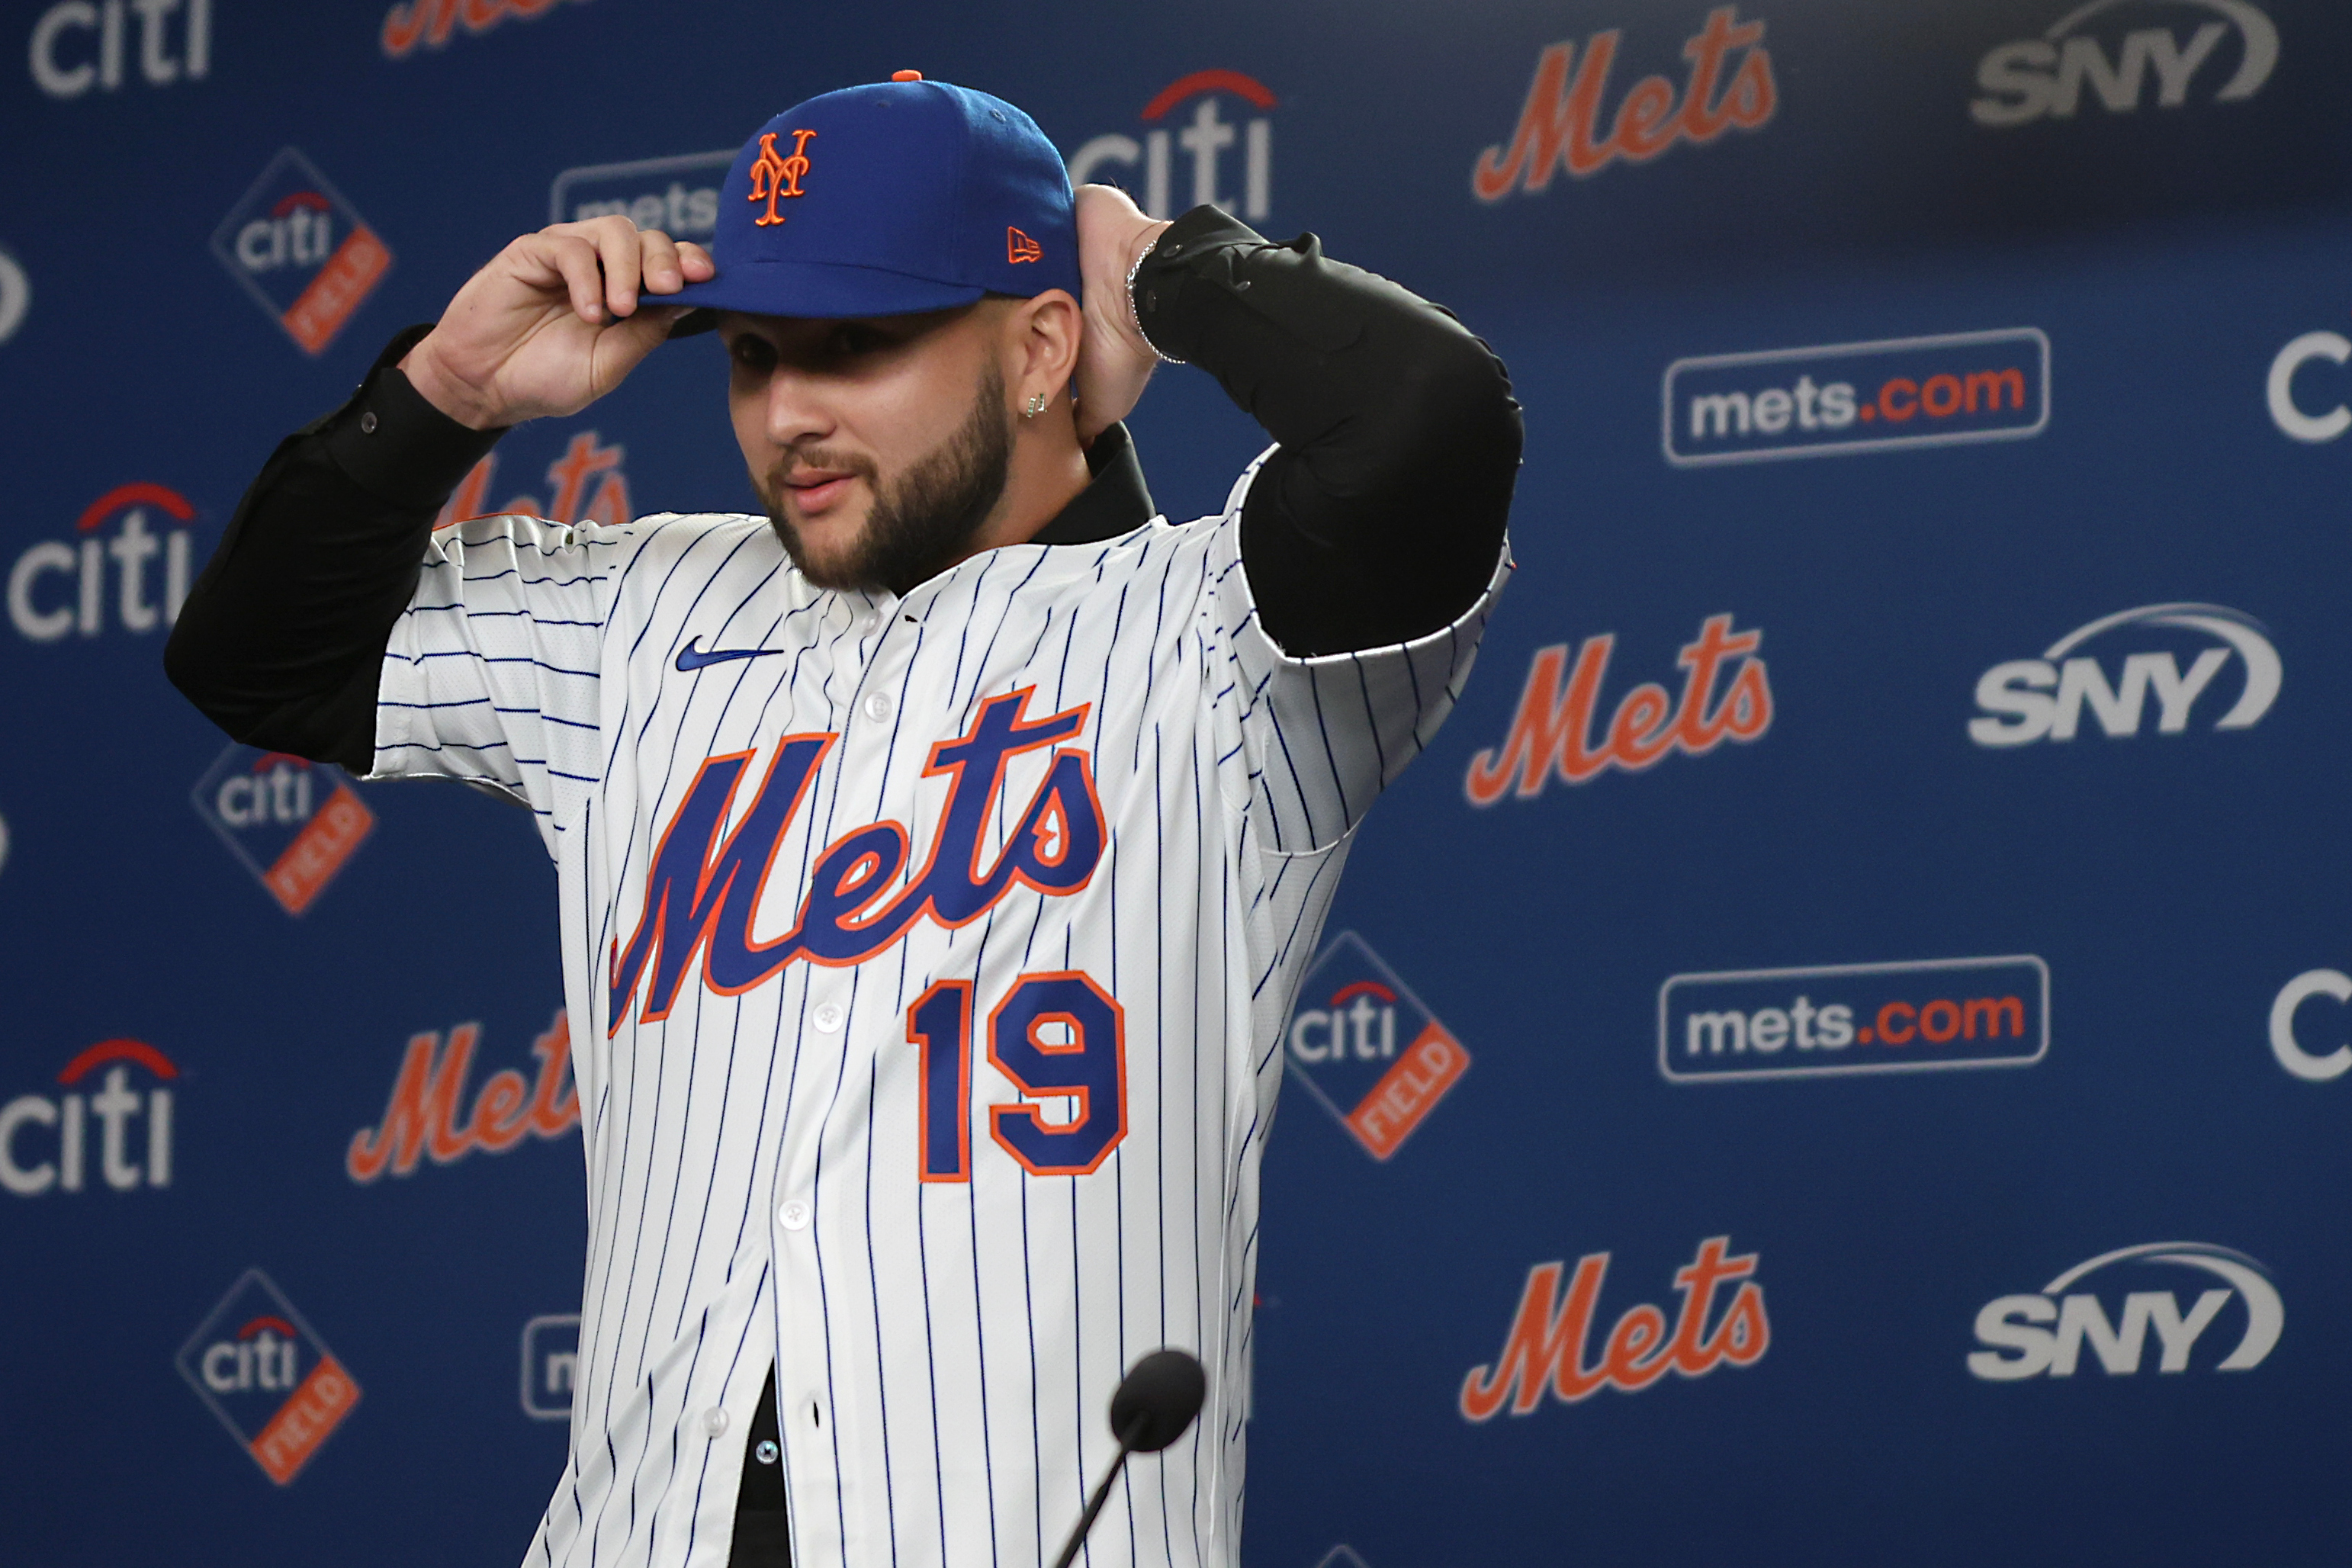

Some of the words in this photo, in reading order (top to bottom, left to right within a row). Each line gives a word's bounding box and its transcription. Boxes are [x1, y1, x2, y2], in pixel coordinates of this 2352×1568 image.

[1471, 5, 1778, 203] Mets
[1969, 24, 2230, 127] SNY
[235, 204, 330, 272] citi
[1691, 368, 2026, 439] mets.com
[8, 506, 191, 641] citi
[1464, 613, 1775, 806] Mets
[1968, 648, 2232, 748] SNY
[217, 760, 312, 828] citi
[608, 684, 1107, 1039] Mets
[907, 969, 1128, 1183] 19
[1290, 994, 1396, 1063] citi
[1685, 991, 2025, 1058] mets.com
[0, 1066, 174, 1197] citi
[345, 1008, 582, 1184] Met
[1360, 1040, 1453, 1144] FIELD
[201, 1329, 297, 1392] citi
[1458, 1235, 1771, 1423] Mets
[1967, 1288, 2233, 1380] SNY
